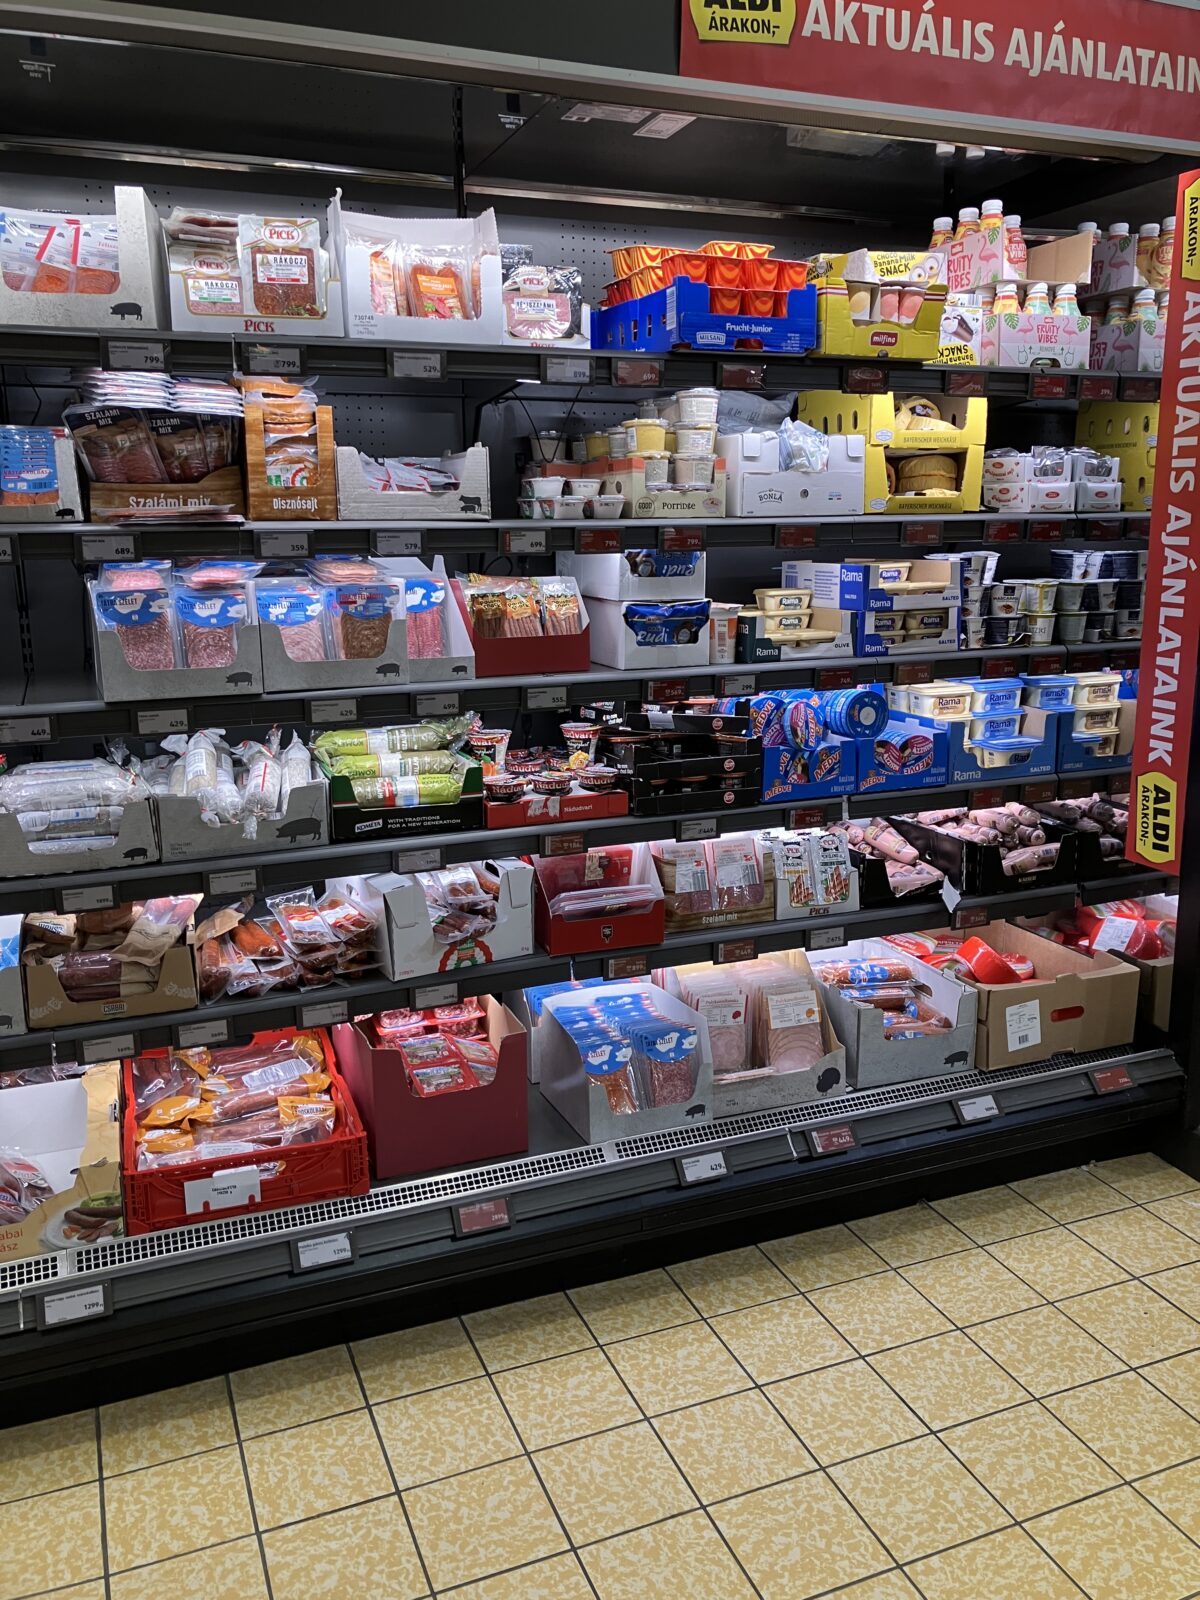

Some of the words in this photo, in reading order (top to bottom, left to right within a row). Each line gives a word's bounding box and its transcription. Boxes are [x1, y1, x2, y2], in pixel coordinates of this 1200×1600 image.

[801, 0, 995, 62] AKTUÁLIS
[268, 229, 295, 240] PICK
[198, 259, 225, 270] PICK
[873, 257, 899, 269] Banana
[947, 253, 974, 273] RUITY
[879, 262, 911, 278] SNACK
[523, 277, 544, 286] PICK
[244, 319, 275, 333] PICK
[726, 322, 773, 333] Frucht-Junior
[1036, 323, 1061, 335] FRUITY
[699, 334, 724, 343] MILSANI
[872, 334, 896, 344] milfina
[1038, 333, 1059, 344] VIBES
[144, 355, 160, 364] 799
[281, 360, 296, 369] 799
[423, 365, 438, 373] 529
[642, 372, 656, 381] 699
[98, 418, 113, 427] MIX
[158, 426, 173, 435] MIX
[273, 496, 318, 512] Disznósajt
[290, 544, 304, 552] 359
[404, 542, 418, 550] 579
[530, 541, 543, 549] 699
[115, 547, 130, 556] 689
[841, 569, 863, 583] Rama
[882, 570, 898, 578] Rama
[782, 597, 799, 605] Rama
[870, 599, 891, 608] Rama
[781, 617, 799, 625] Rama
[875, 618, 892, 627] Rama
[923, 615, 940, 624] Rama
[636, 627, 670, 644] Rudi
[1148, 504, 1197, 766] AJÁNLATAINK
[756, 647, 779, 658] Rama
[938, 697, 961, 707] Rama
[989, 692, 1012, 703] Rama
[443, 702, 456, 711] 499
[752, 699, 776, 737] MEDVE
[169, 719, 184, 728] 429
[989, 719, 1011, 730] Rama
[31, 728, 47, 737] 449
[903, 752, 933, 775] MEDVE
[1030, 765, 1051, 773] SALTED
[954, 769, 982, 781] Rama
[860, 775, 886, 791] MEDVE
[765, 784, 792, 801] MEDVE
[387, 817, 405, 825] WITH
[405, 815, 440, 823] TRADITIONS
[423, 818, 461, 827] GENERATION
[1152, 784, 1171, 853] ALDI
[727, 912, 738, 921] mix
[809, 906, 831, 917] PICK
[710, 1163, 723, 1172] 429
[84, 1302, 99, 1312] 1299
